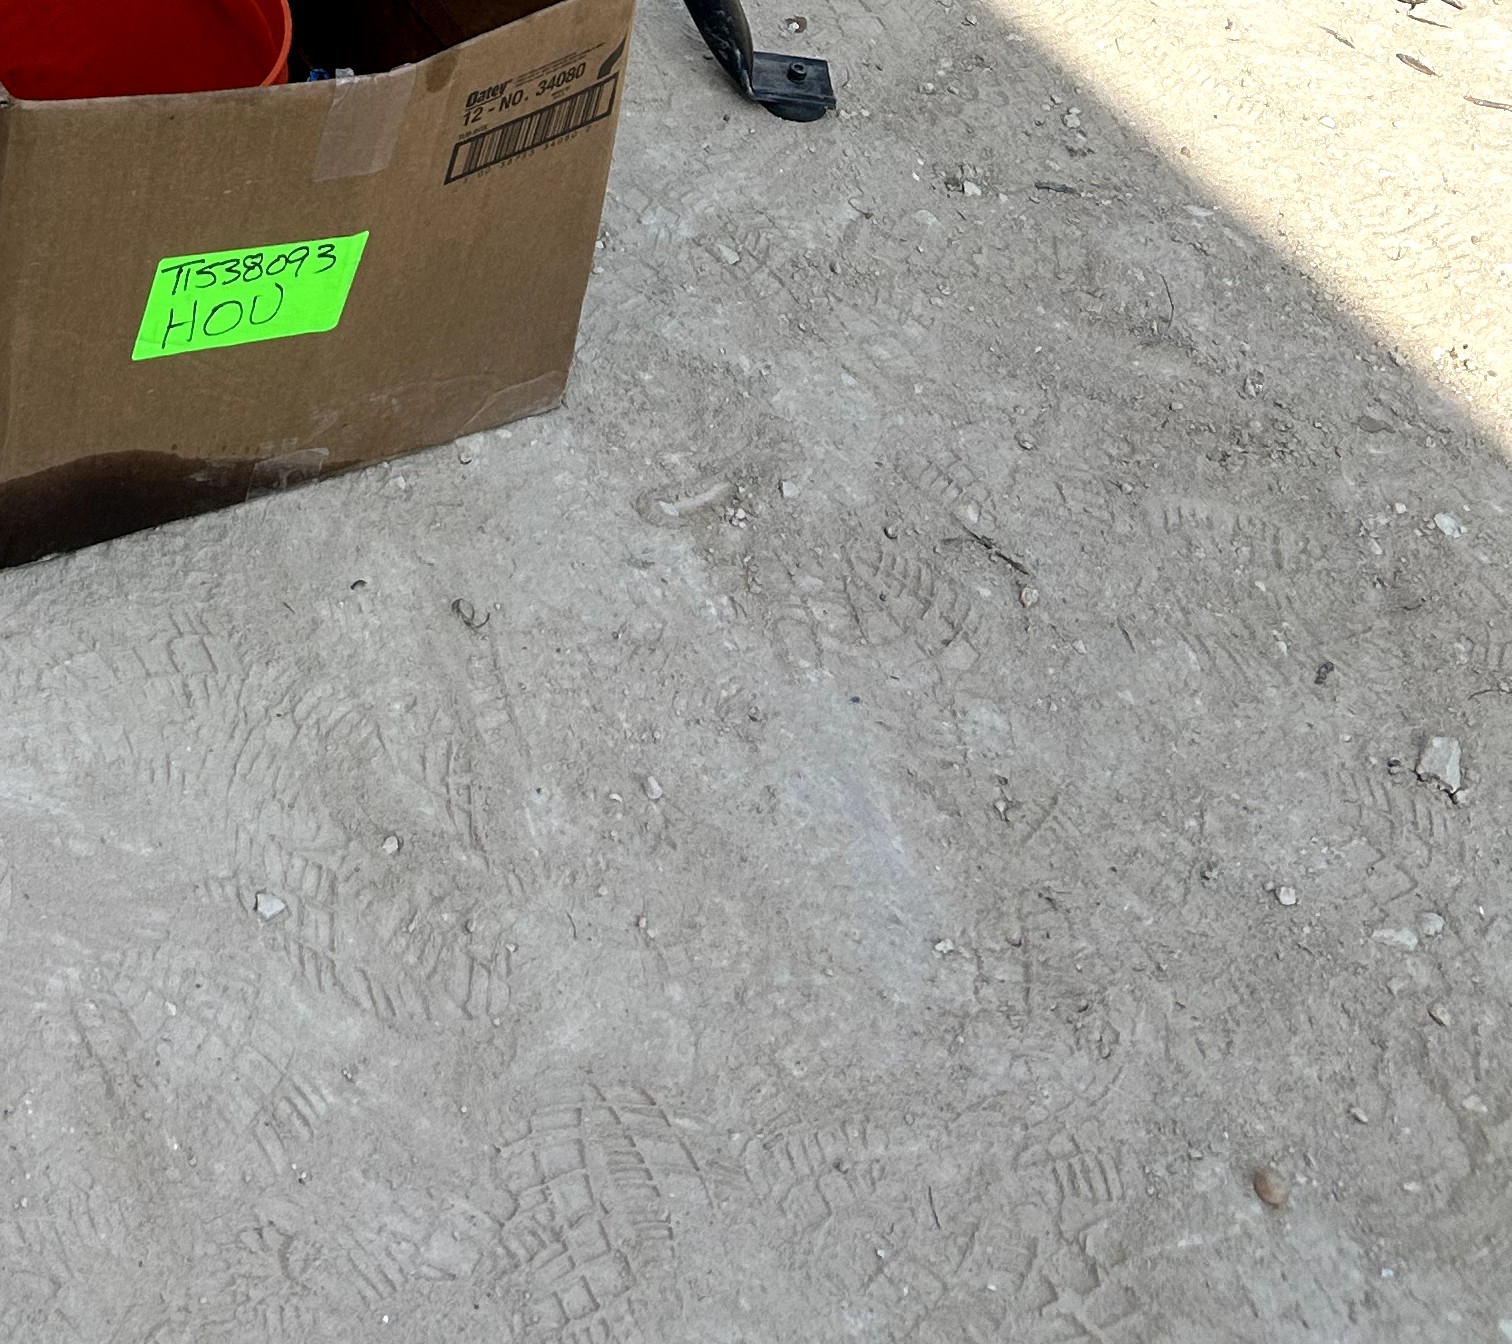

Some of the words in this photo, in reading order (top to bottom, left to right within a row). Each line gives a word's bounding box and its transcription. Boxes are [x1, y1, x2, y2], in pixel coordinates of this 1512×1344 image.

[463, 107, 484, 127] 12
[536, 62, 587, 97] 34080
[465, 78, 513, 109] Oatey
[162, 282, 284, 350] HOU
